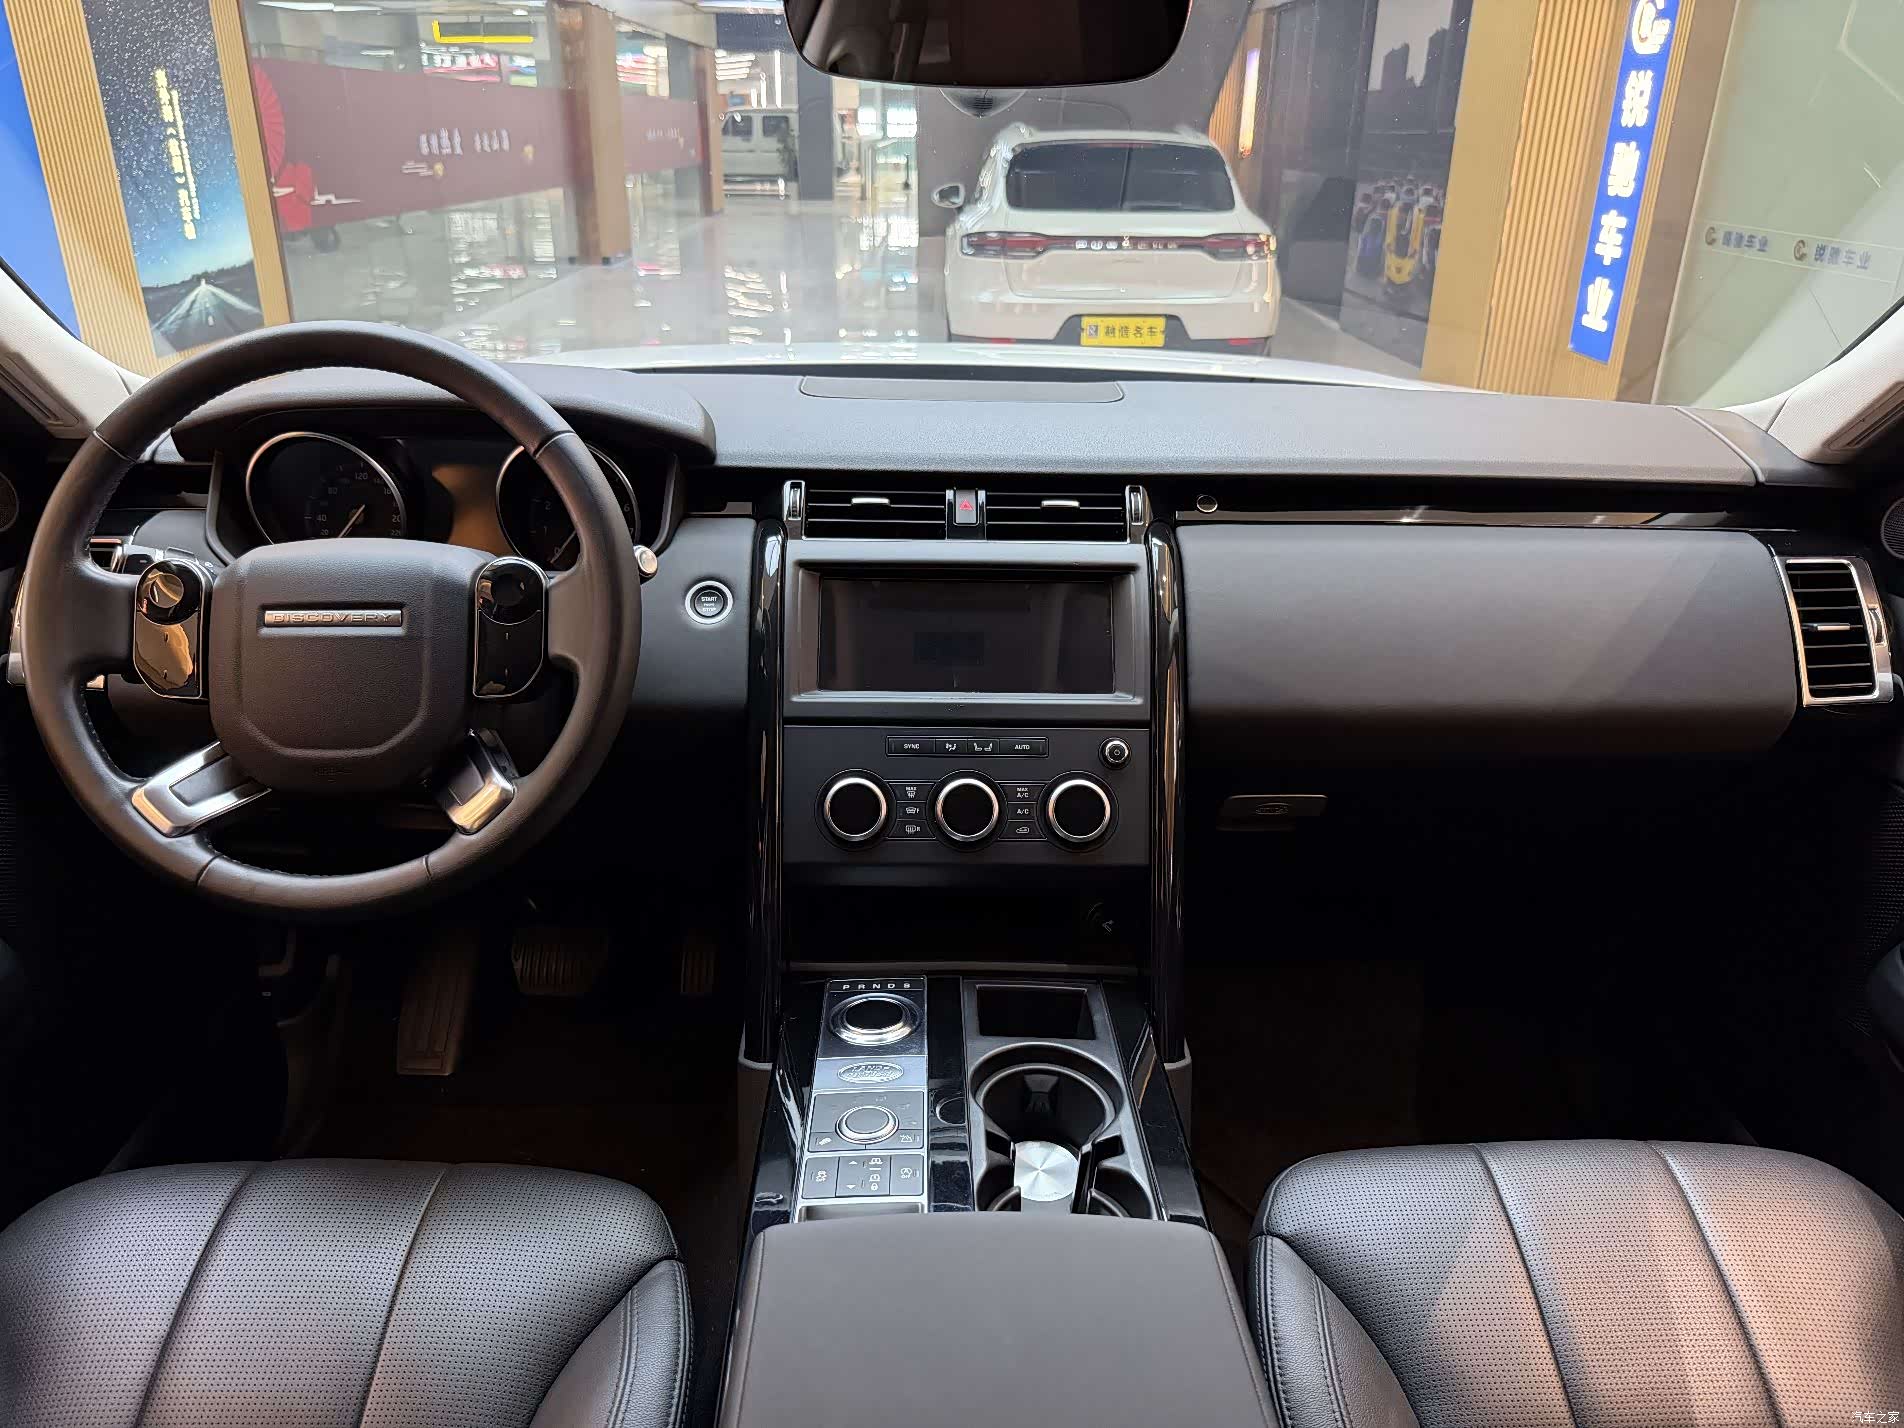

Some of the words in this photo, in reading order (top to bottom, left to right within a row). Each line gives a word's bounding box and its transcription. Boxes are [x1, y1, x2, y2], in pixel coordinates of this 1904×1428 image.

[354, 472, 369, 480] 120
[623, 503, 630, 512] 6
[272, 612, 393, 624] DISCOVERY
